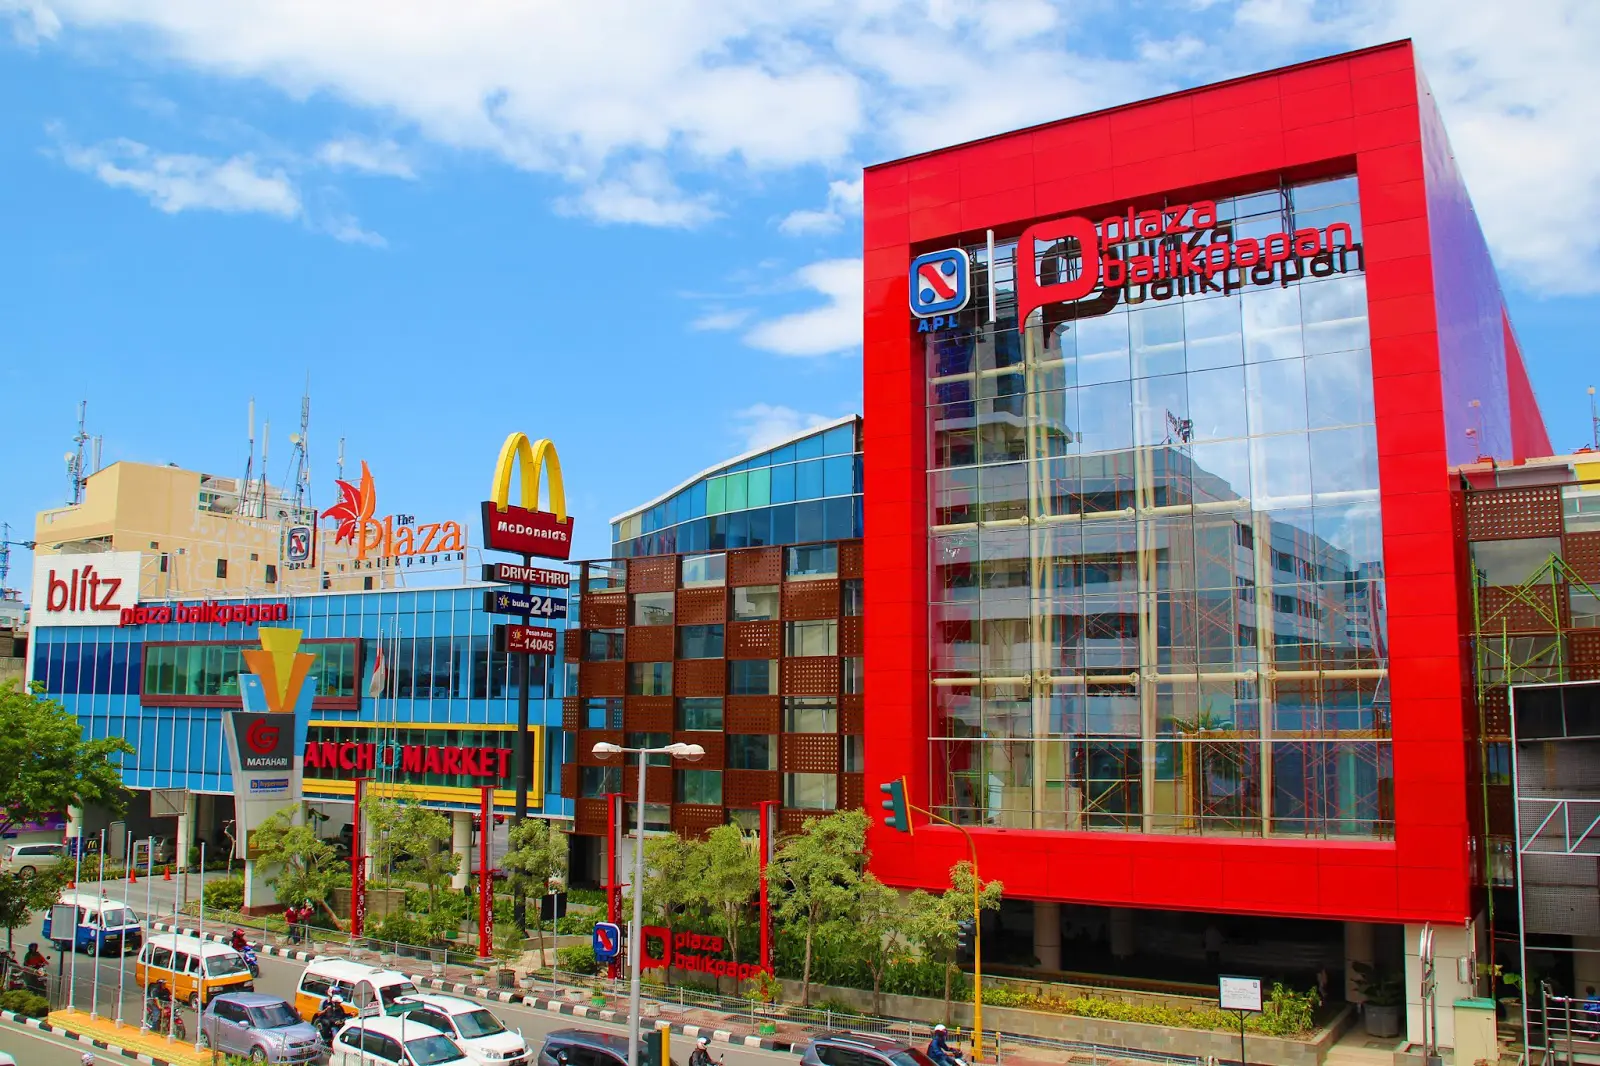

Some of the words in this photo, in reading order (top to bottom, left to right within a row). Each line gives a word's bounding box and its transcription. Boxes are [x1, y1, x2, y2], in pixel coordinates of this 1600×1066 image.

[1102, 200, 1217, 251] plaza
[1103, 222, 1353, 288] balikpapan
[917, 315, 959, 333] APL
[396, 514, 415, 527] The
[497, 521, 567, 542] McDonald's
[355, 551, 464, 570] Balikpapan
[501, 565, 569, 585] DRIVE-THRU
[120, 603, 172, 628] plaza
[176, 601, 287, 626] balikpapan
[512, 599, 529, 609] buka
[530, 596, 552, 616] 24
[553, 602, 566, 613] jam
[526, 628, 540, 637] Pesan
[524, 638, 554, 652] 14045
[247, 757, 287, 766] MATAHARI
[304, 741, 376, 770] ANCH
[402, 744, 513, 779] MARKET
[675, 930, 724, 952] plaza
